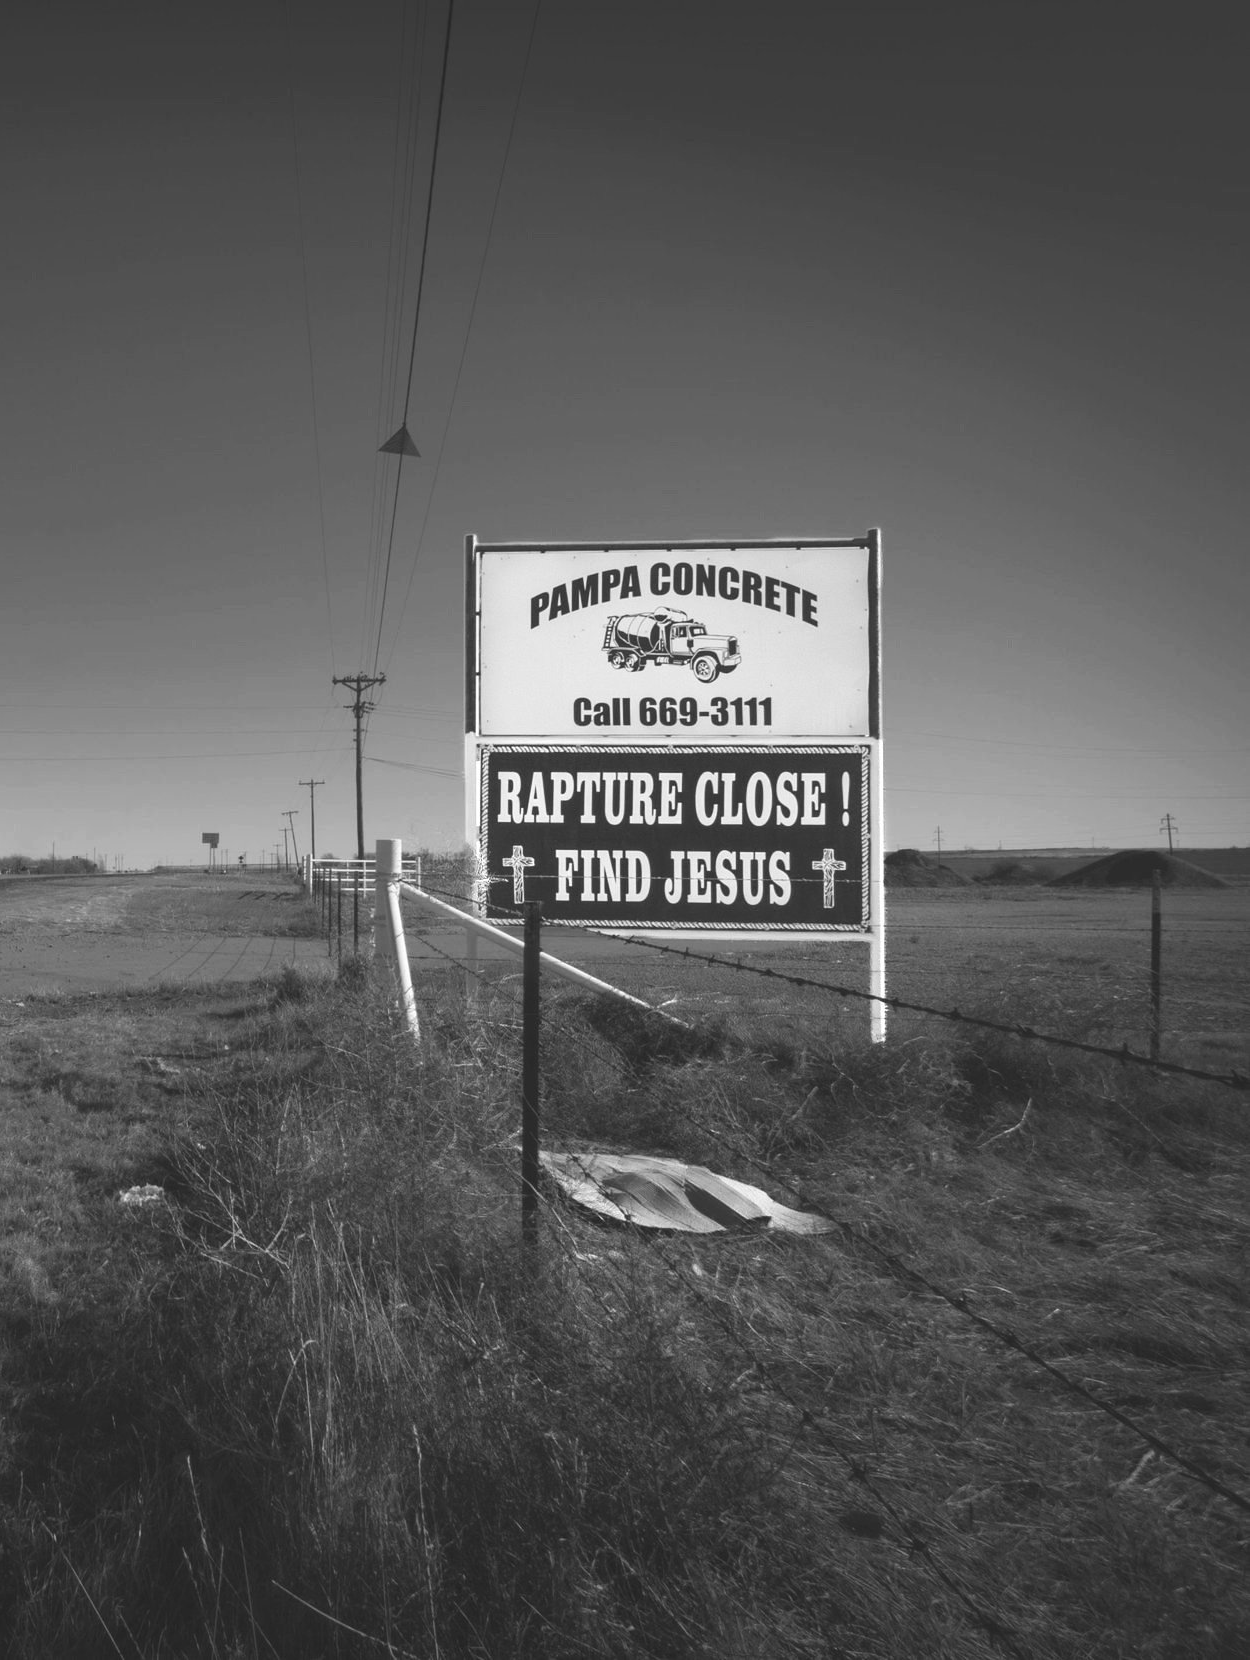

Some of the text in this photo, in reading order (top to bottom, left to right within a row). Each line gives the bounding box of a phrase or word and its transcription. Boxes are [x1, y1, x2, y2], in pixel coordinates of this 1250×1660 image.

[530, 563, 819, 629] PAMPA CONCRETE
[573, 697, 772, 726] Call 669-3111
[497, 771, 682, 825] RAPTURE
[695, 771, 826, 826] CLOSE
[555, 849, 792, 906] FIND JESUS
